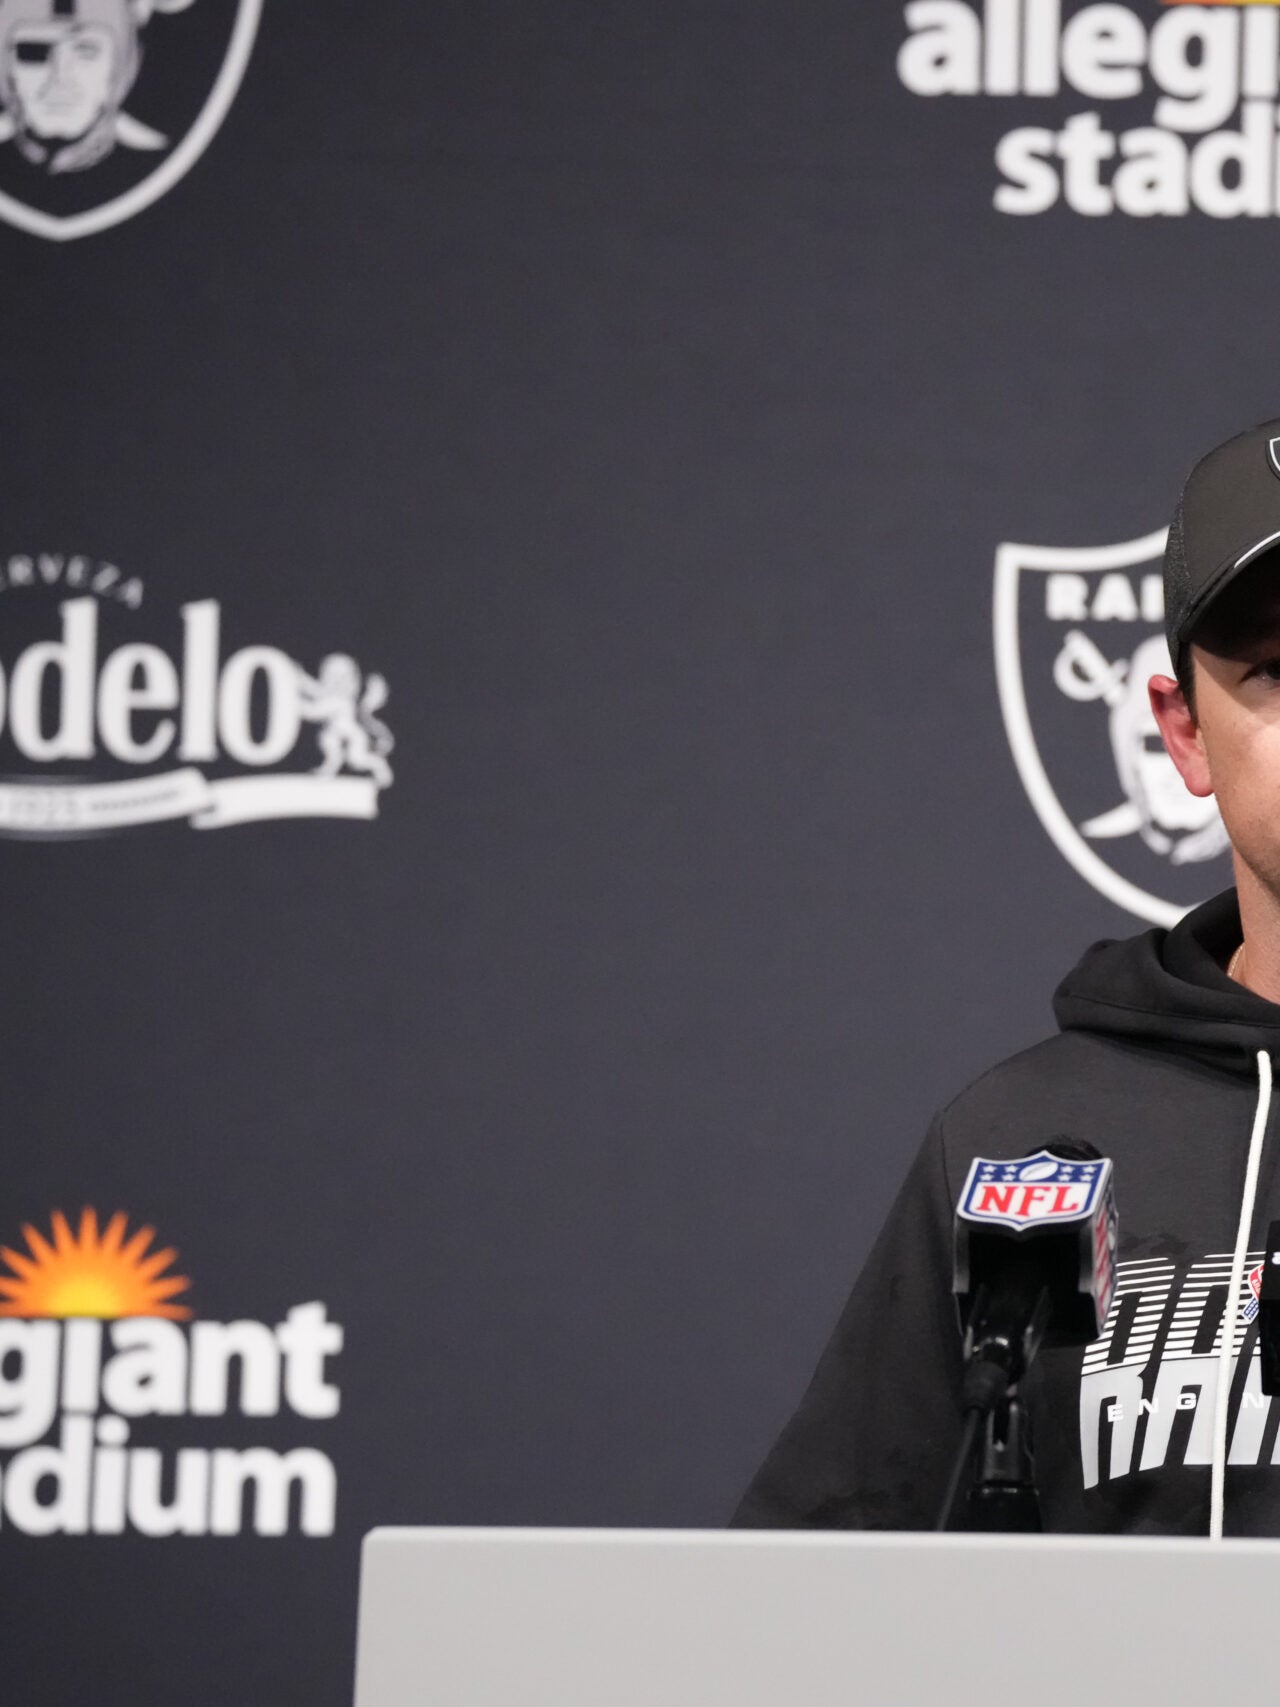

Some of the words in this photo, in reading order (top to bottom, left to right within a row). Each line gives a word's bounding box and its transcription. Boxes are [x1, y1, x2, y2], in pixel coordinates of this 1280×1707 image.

[0, 553, 143, 609] RVEZA
[0, 596, 303, 766] delo
[976, 1185, 1079, 1217] NFL
[0, 1413, 338, 1537] dium
